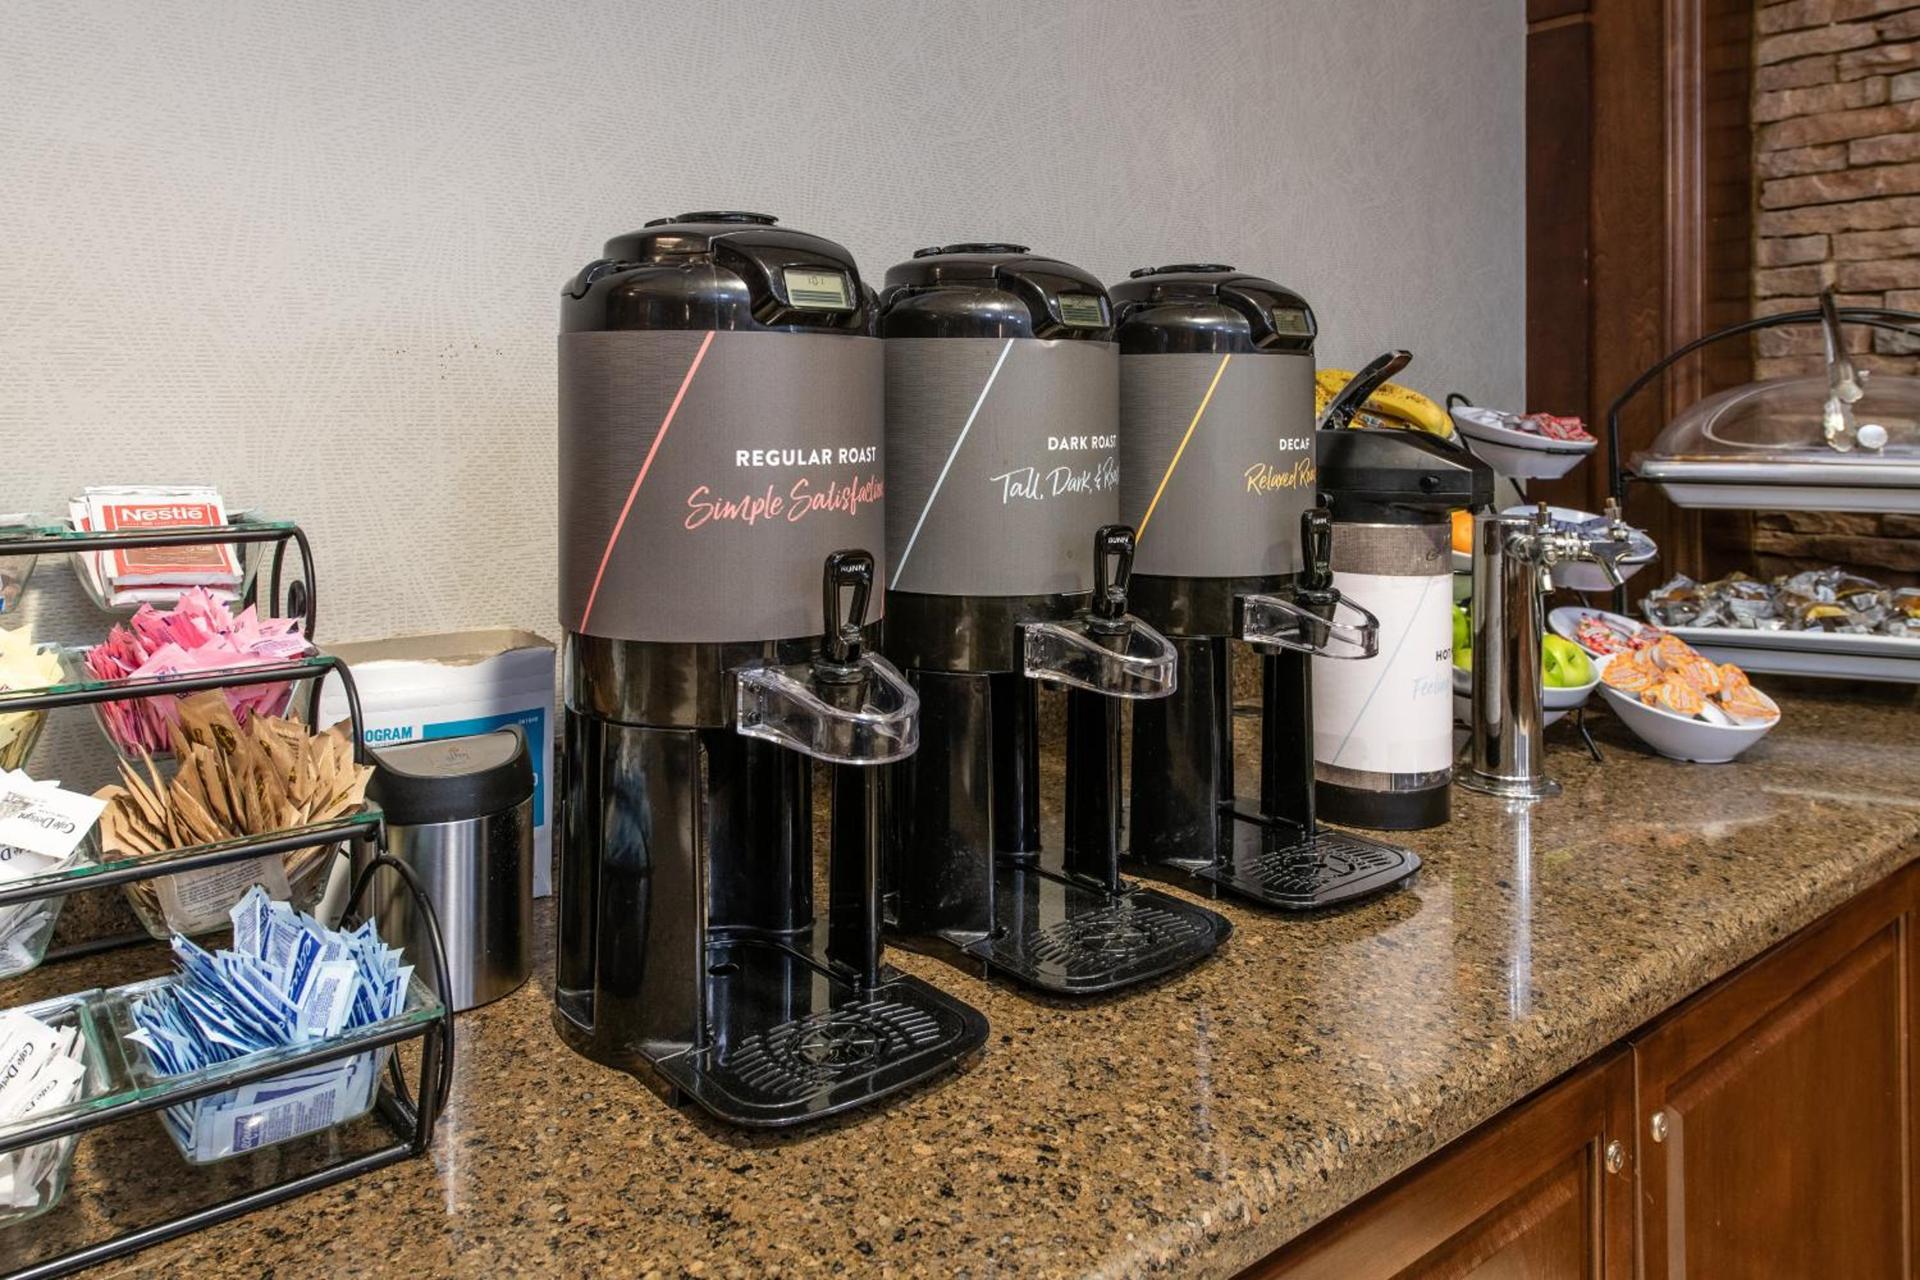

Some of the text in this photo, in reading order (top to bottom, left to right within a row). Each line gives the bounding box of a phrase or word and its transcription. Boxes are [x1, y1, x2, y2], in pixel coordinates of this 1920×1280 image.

[1048, 434, 1117, 451] DARK ROAST
[1279, 437, 1310, 451] DECAF
[736, 446, 877, 467] REGULAR ROAST
[1244, 462, 1297, 496] Relaxed
[685, 484, 784, 530] Simple
[365, 726, 413, 743] OGRAM
